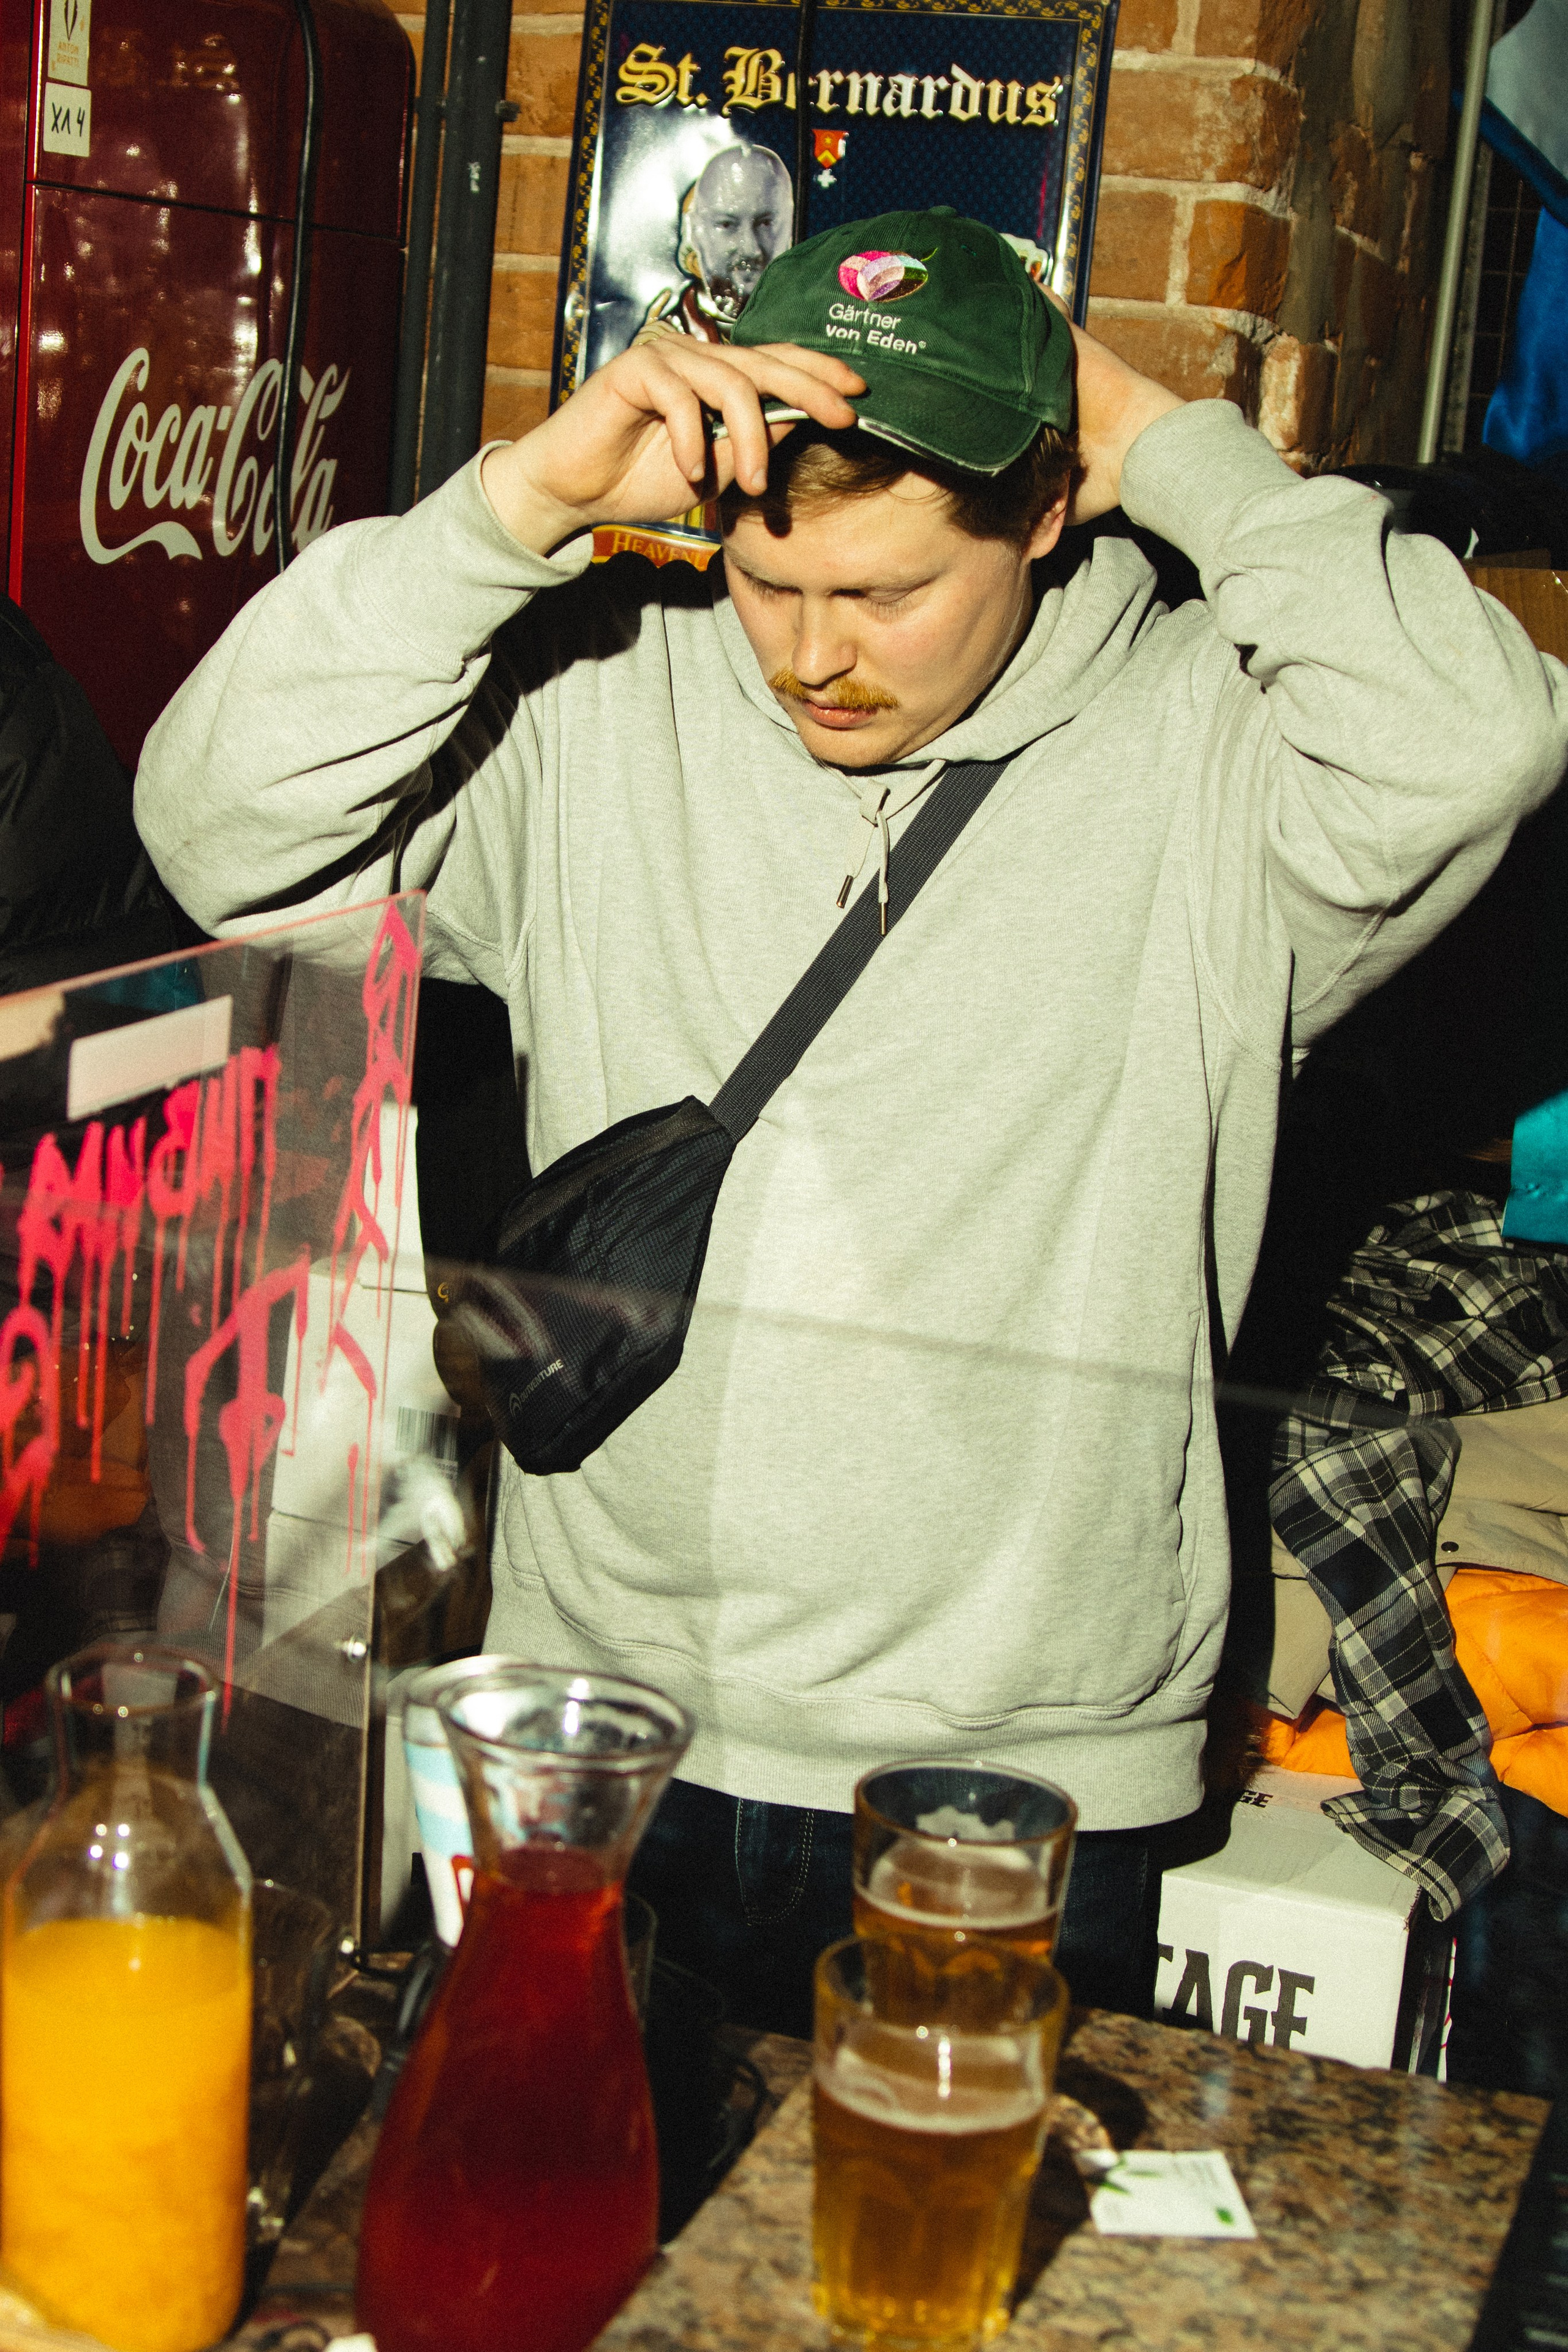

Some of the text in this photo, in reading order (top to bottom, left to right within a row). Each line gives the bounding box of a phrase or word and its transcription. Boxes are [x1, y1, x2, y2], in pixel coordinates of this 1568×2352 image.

[616, 43, 711, 109] St.
[826, 323, 861, 341] von
[829, 303, 902, 331] Gärtner
[80, 347, 351, 565] Coca-Cola
[520, 1359, 564, 1403] OUTVENTURE
